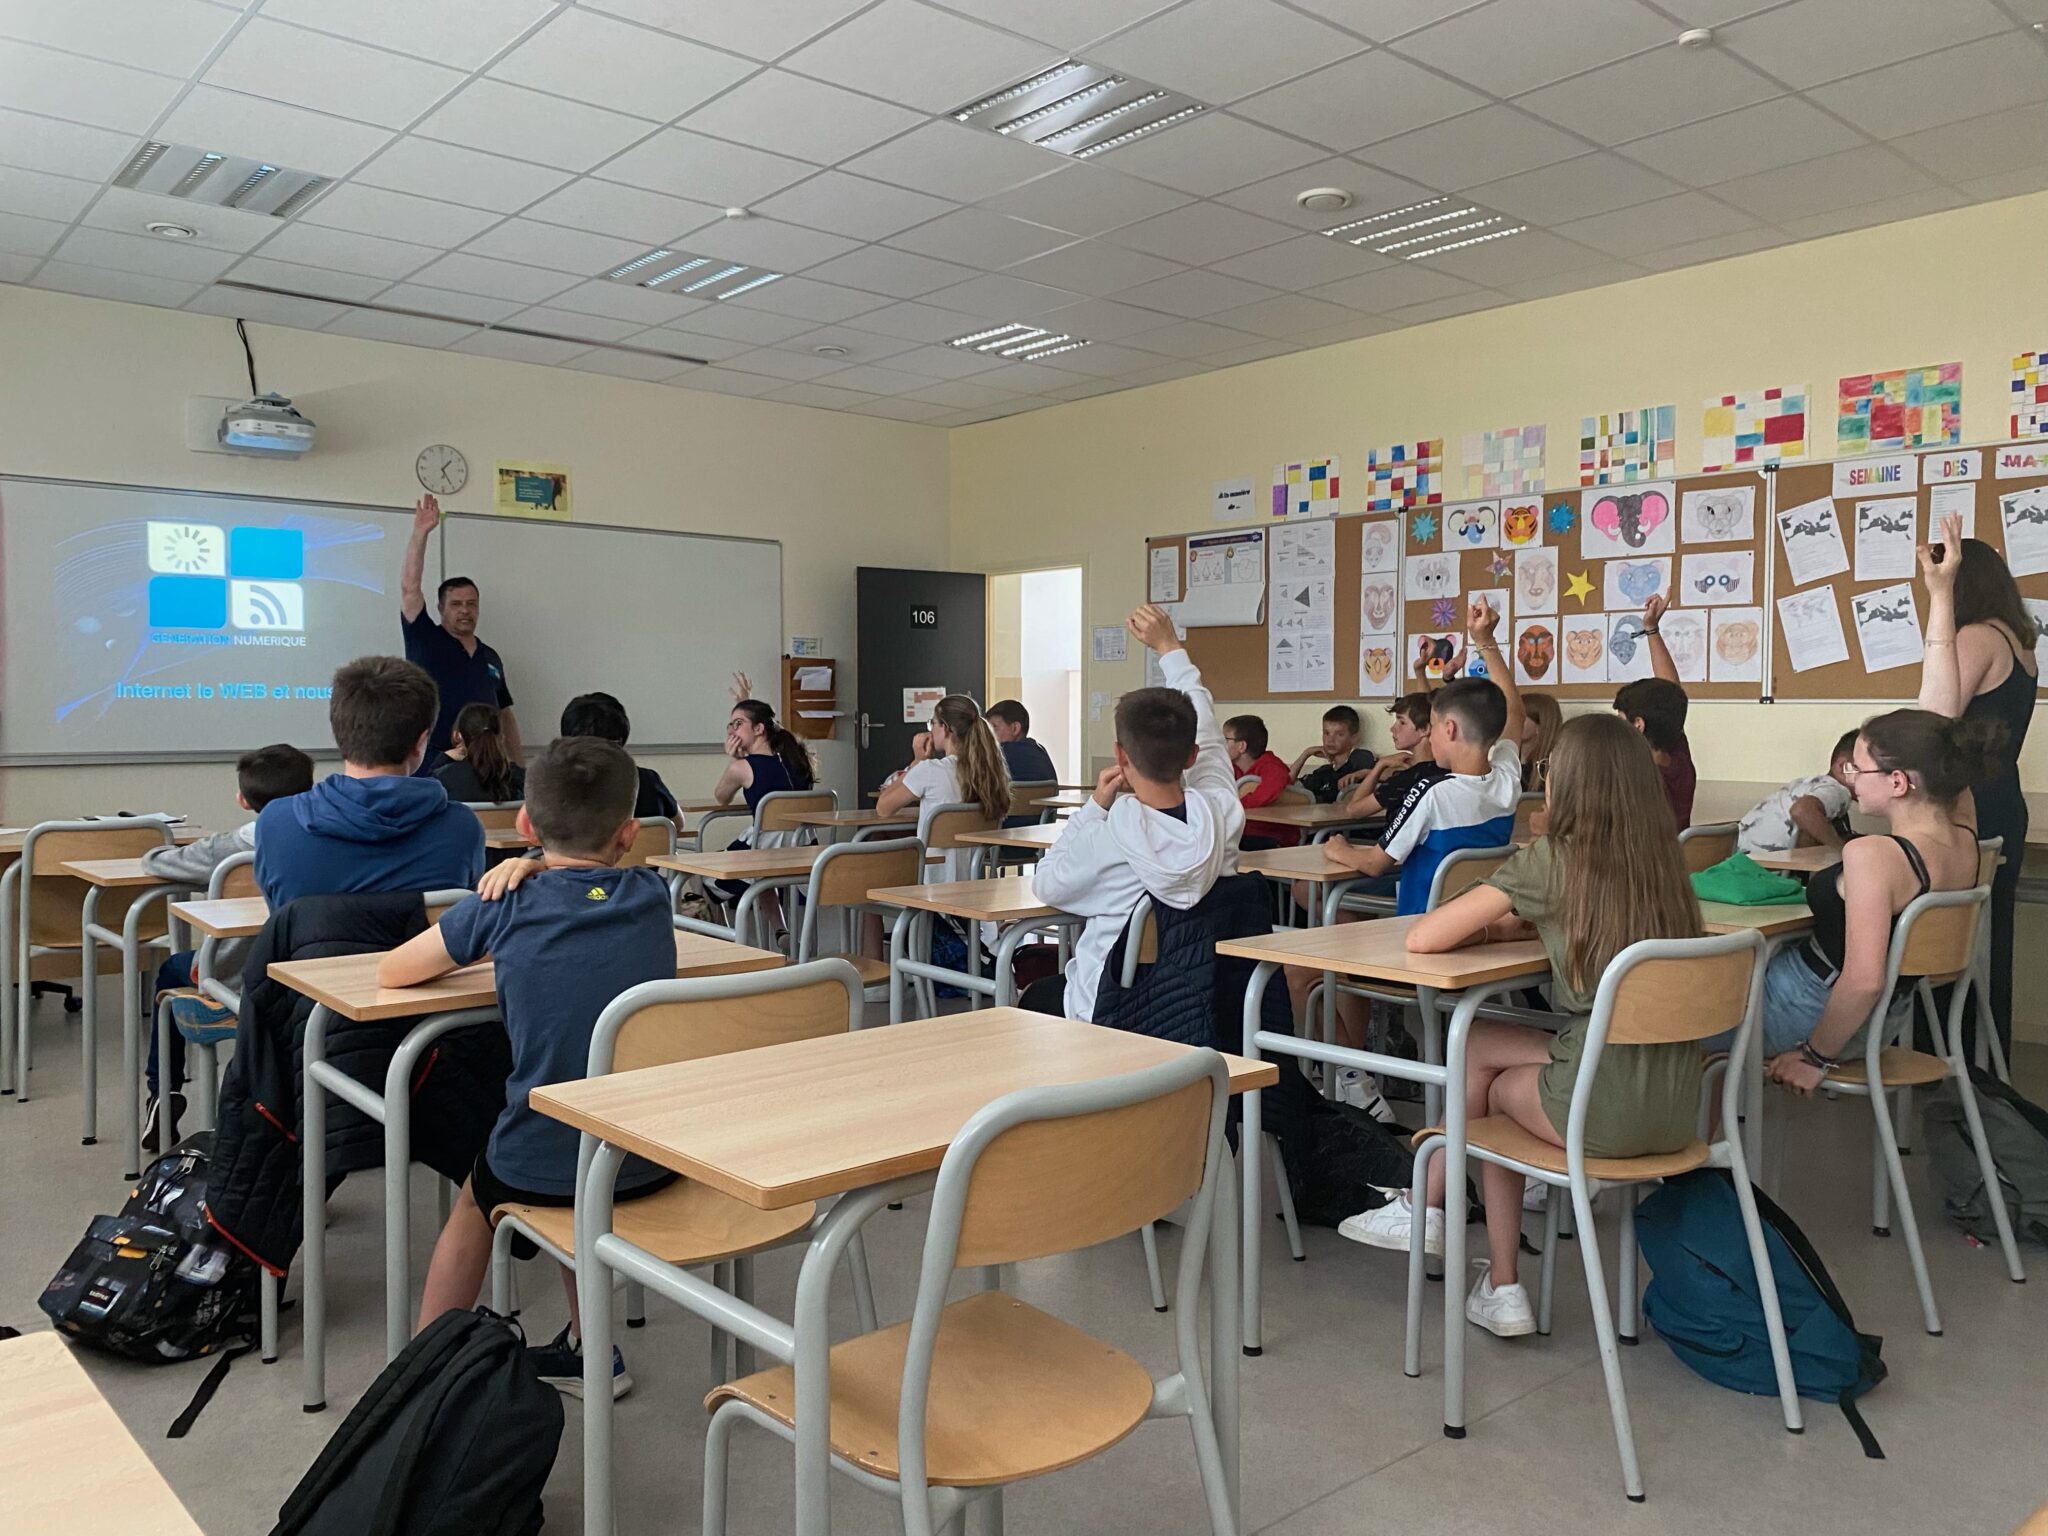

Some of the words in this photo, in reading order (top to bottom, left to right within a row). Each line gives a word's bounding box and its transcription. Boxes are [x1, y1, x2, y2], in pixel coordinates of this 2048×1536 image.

[1850, 465, 1901, 486] SEMAINE
[1943, 459, 1968, 477] DES
[912, 610, 935, 624] 106
[233, 635, 307, 647] NUMERIQUE
[117, 682, 191, 699] Internet
[199, 682, 213, 699] le
[219, 683, 266, 699] WEB
[272, 684, 289, 699] et
[1418, 778, 1430, 790] LE
[1403, 787, 1420, 808] COQ
